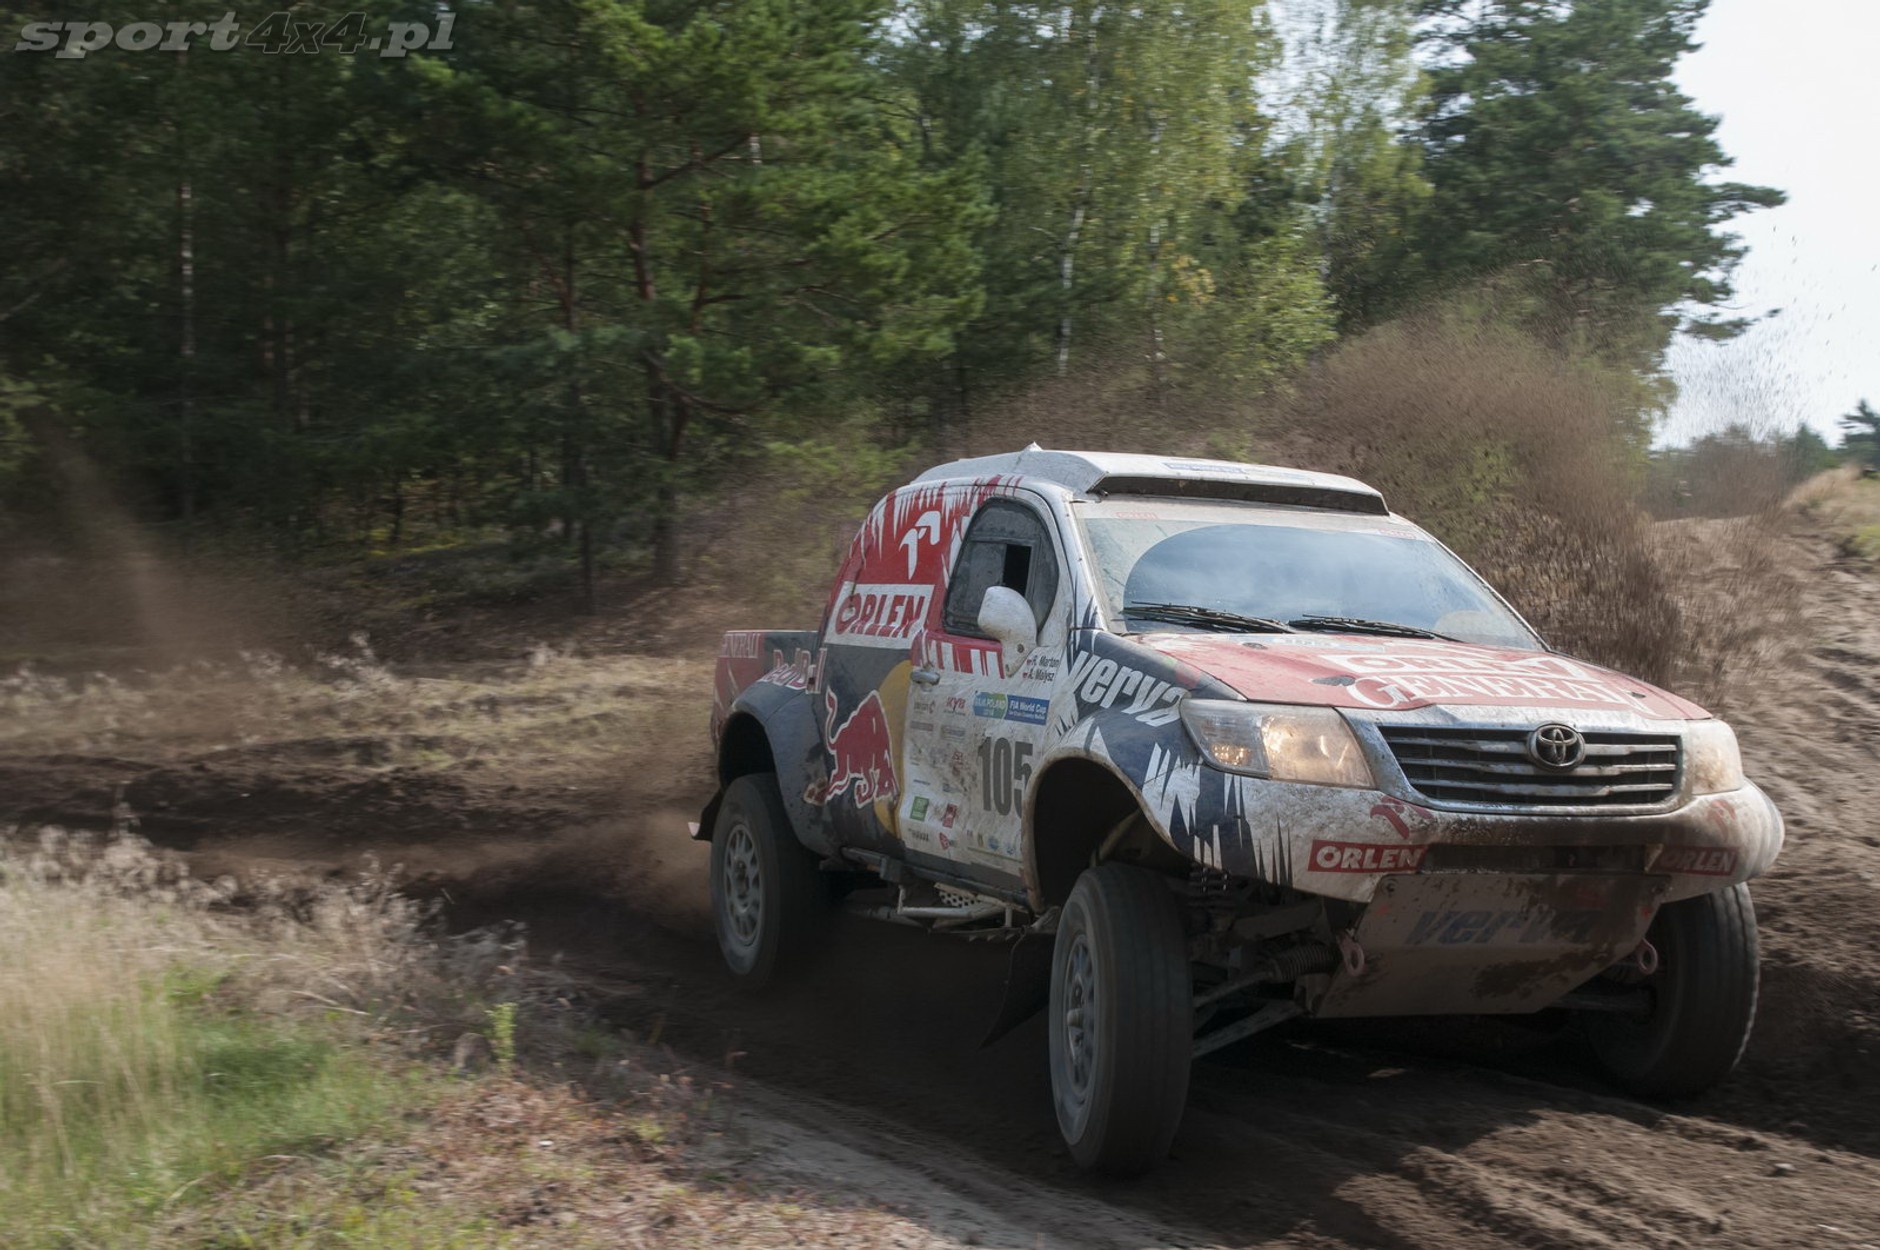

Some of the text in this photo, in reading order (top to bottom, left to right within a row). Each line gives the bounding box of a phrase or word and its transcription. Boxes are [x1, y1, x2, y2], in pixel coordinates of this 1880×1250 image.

[835, 593, 925, 638] ORLEN
[1020, 701, 1036, 712] World
[1066, 650, 1193, 727] verva
[978, 736, 1033, 820] 105
[1316, 845, 1423, 869] ORLEN
